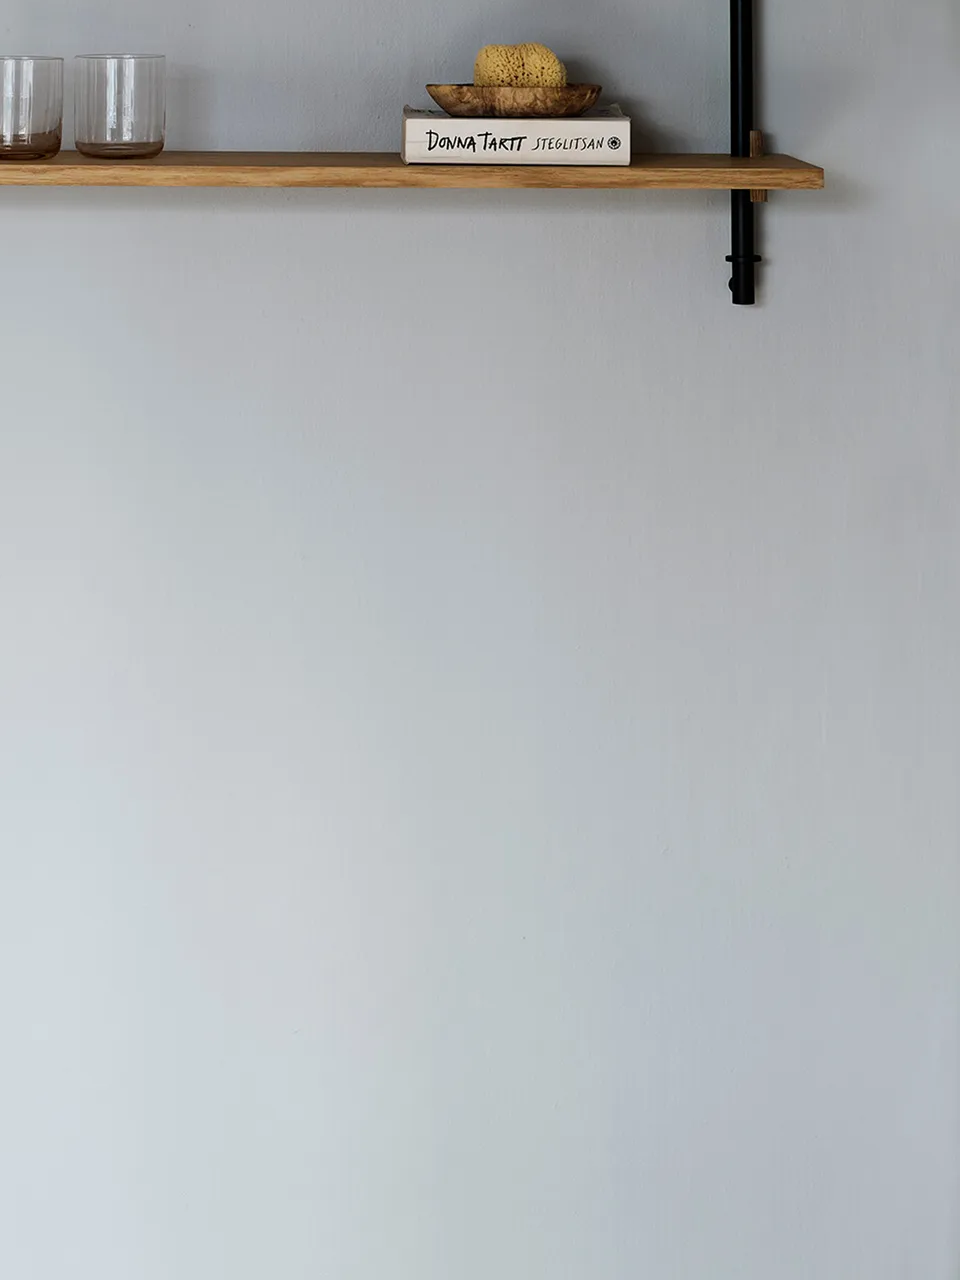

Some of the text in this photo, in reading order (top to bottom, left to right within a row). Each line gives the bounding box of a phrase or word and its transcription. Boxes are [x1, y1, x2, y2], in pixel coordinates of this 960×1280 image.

[426, 129, 476, 152] DONNA
[477, 131, 527, 152] TARTT
[531, 136, 604, 151] STEGLITSAN
